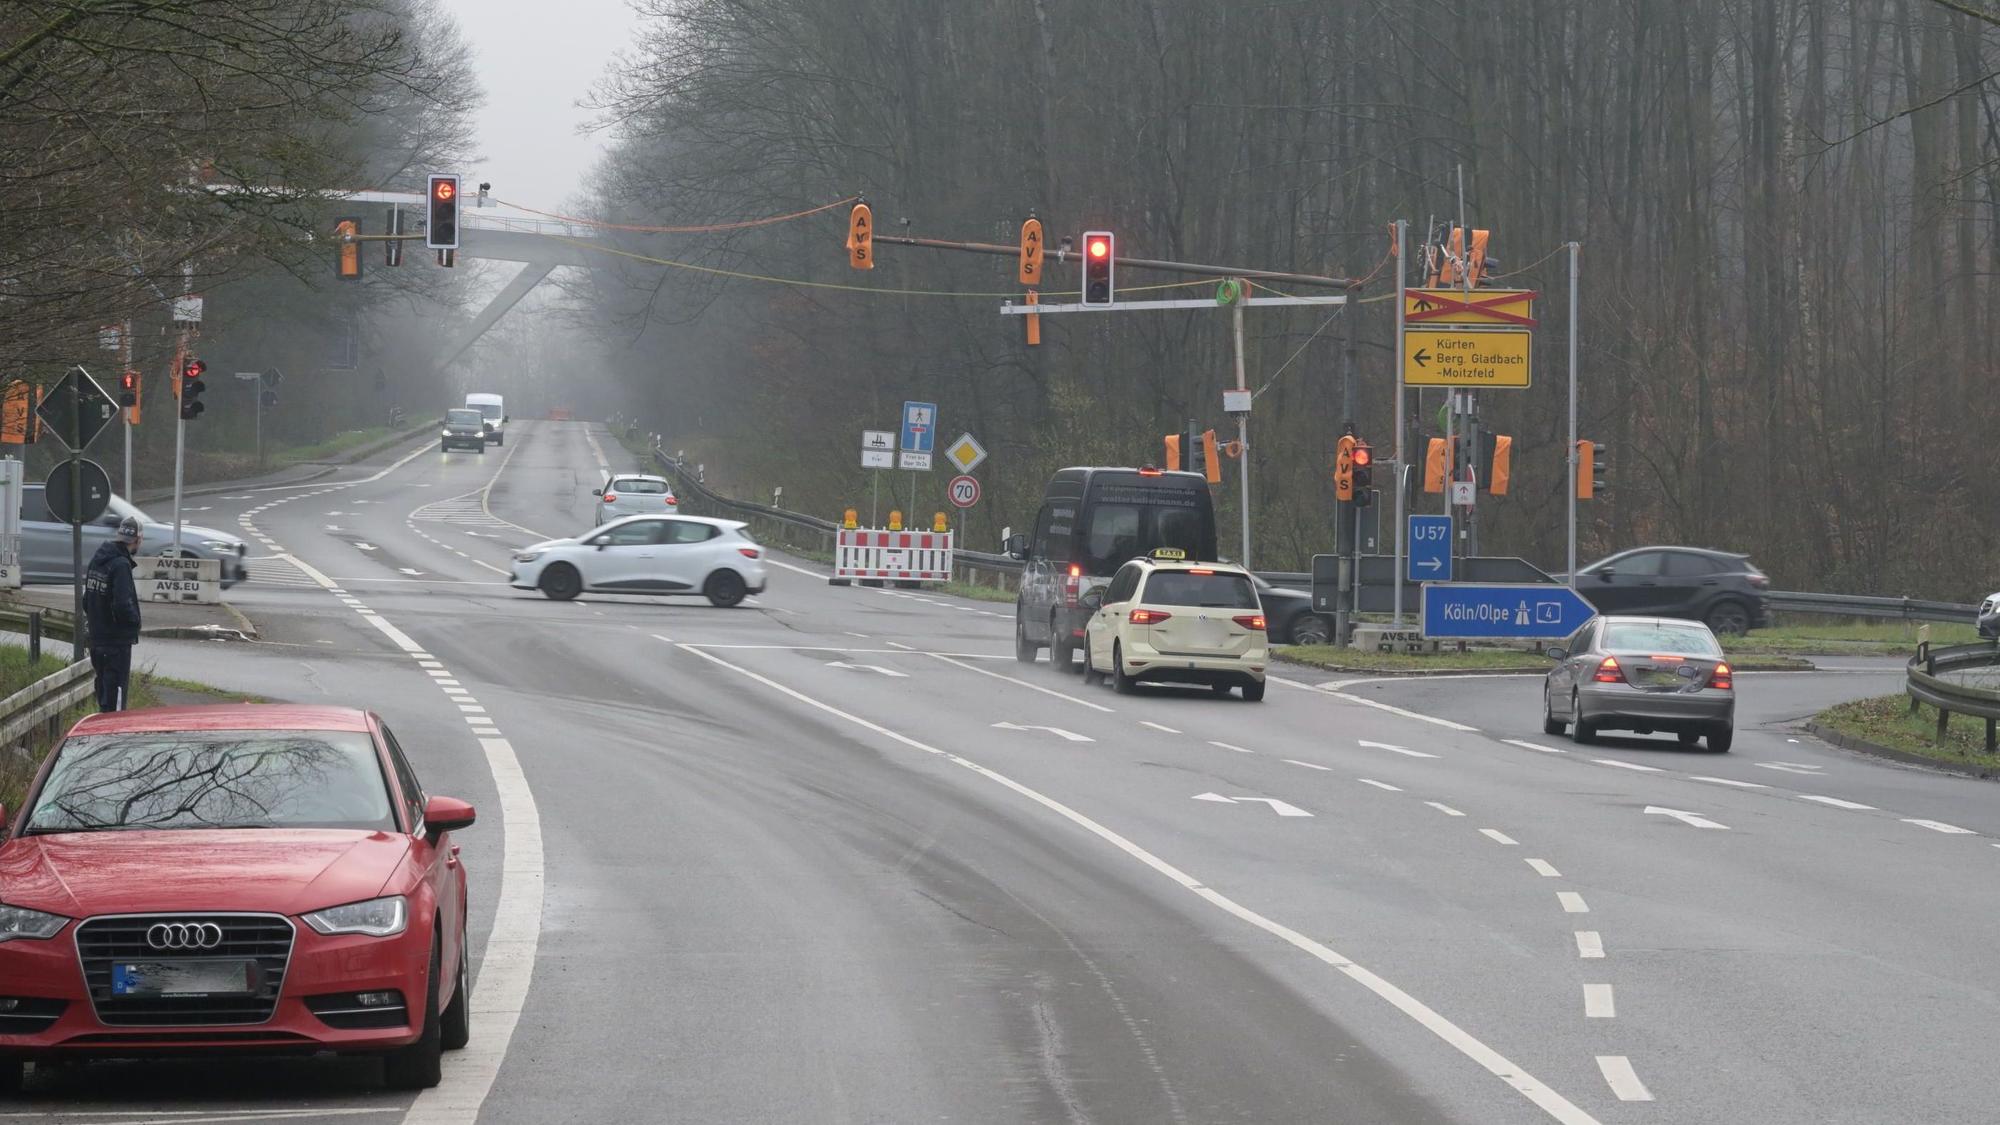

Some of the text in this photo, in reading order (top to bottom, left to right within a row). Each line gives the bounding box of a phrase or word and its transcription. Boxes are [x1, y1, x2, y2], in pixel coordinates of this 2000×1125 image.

[856, 216, 867, 260] AVS
[1024, 231, 1037, 274] AVS
[1437, 339, 1475, 349] Kürten
[1437, 353, 1524, 365] Berg. Gladbach
[1437, 367, 1495, 378] -Moitzfeld
[1340, 447, 1351, 490] AVS
[956, 485, 973, 498] 70
[1415, 526, 1447, 540] U 57
[157, 560, 200, 569] AVS.EU
[156, 582, 200, 591] AVS.EU
[1444, 603, 1553, 625] Köln/Olpe 4
